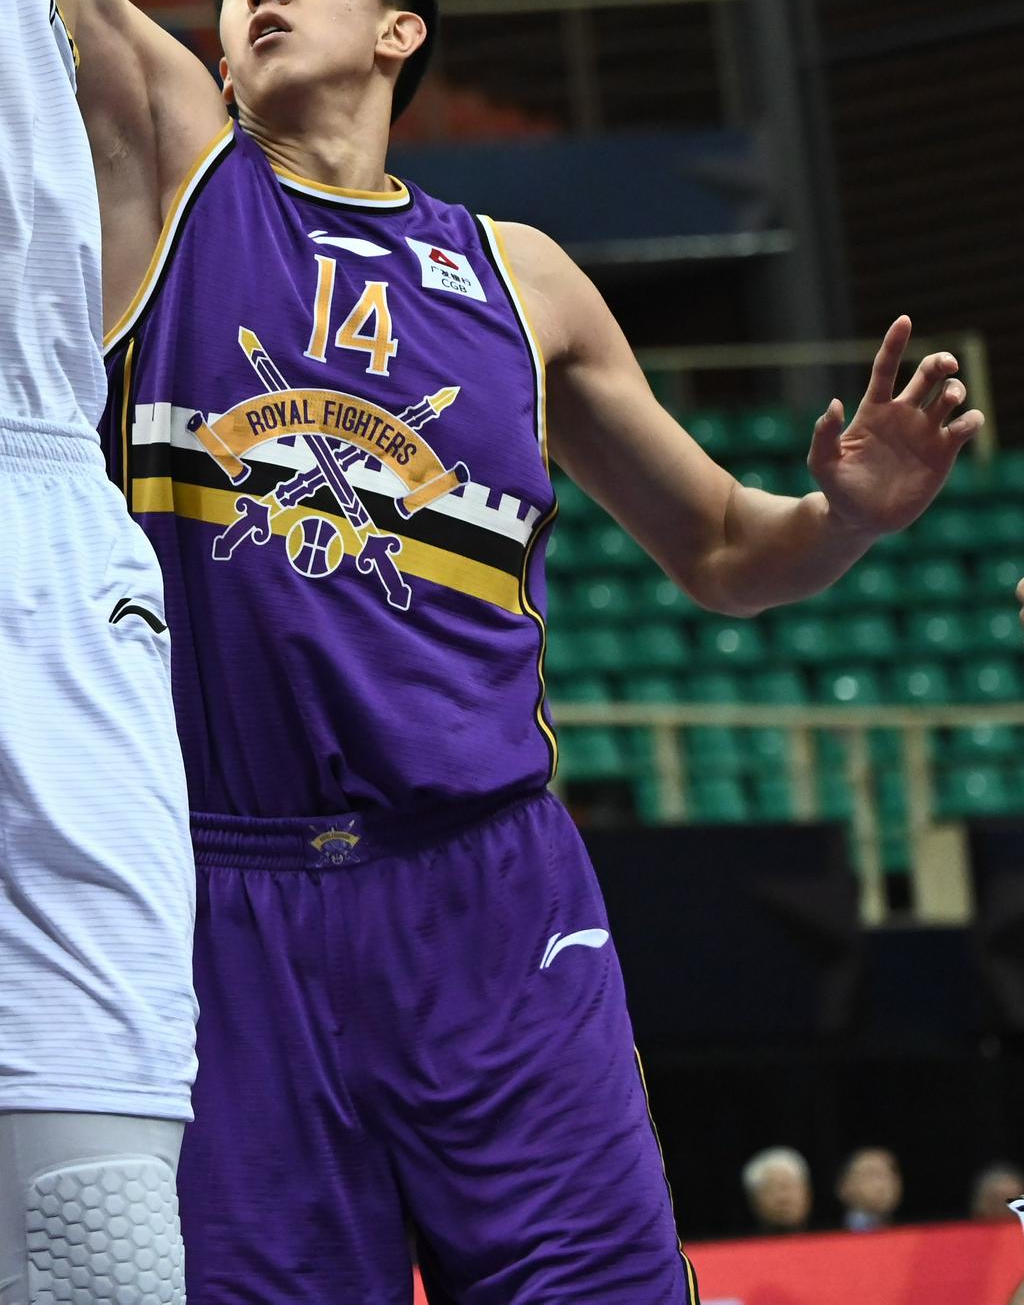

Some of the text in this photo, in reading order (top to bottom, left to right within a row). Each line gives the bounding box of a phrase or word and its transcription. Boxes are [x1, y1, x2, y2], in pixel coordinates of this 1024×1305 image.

[303, 254, 398, 376] 14
[441, 279, 467, 293] CGB
[245, 399, 417, 466] ROYAL FIGHTERS
